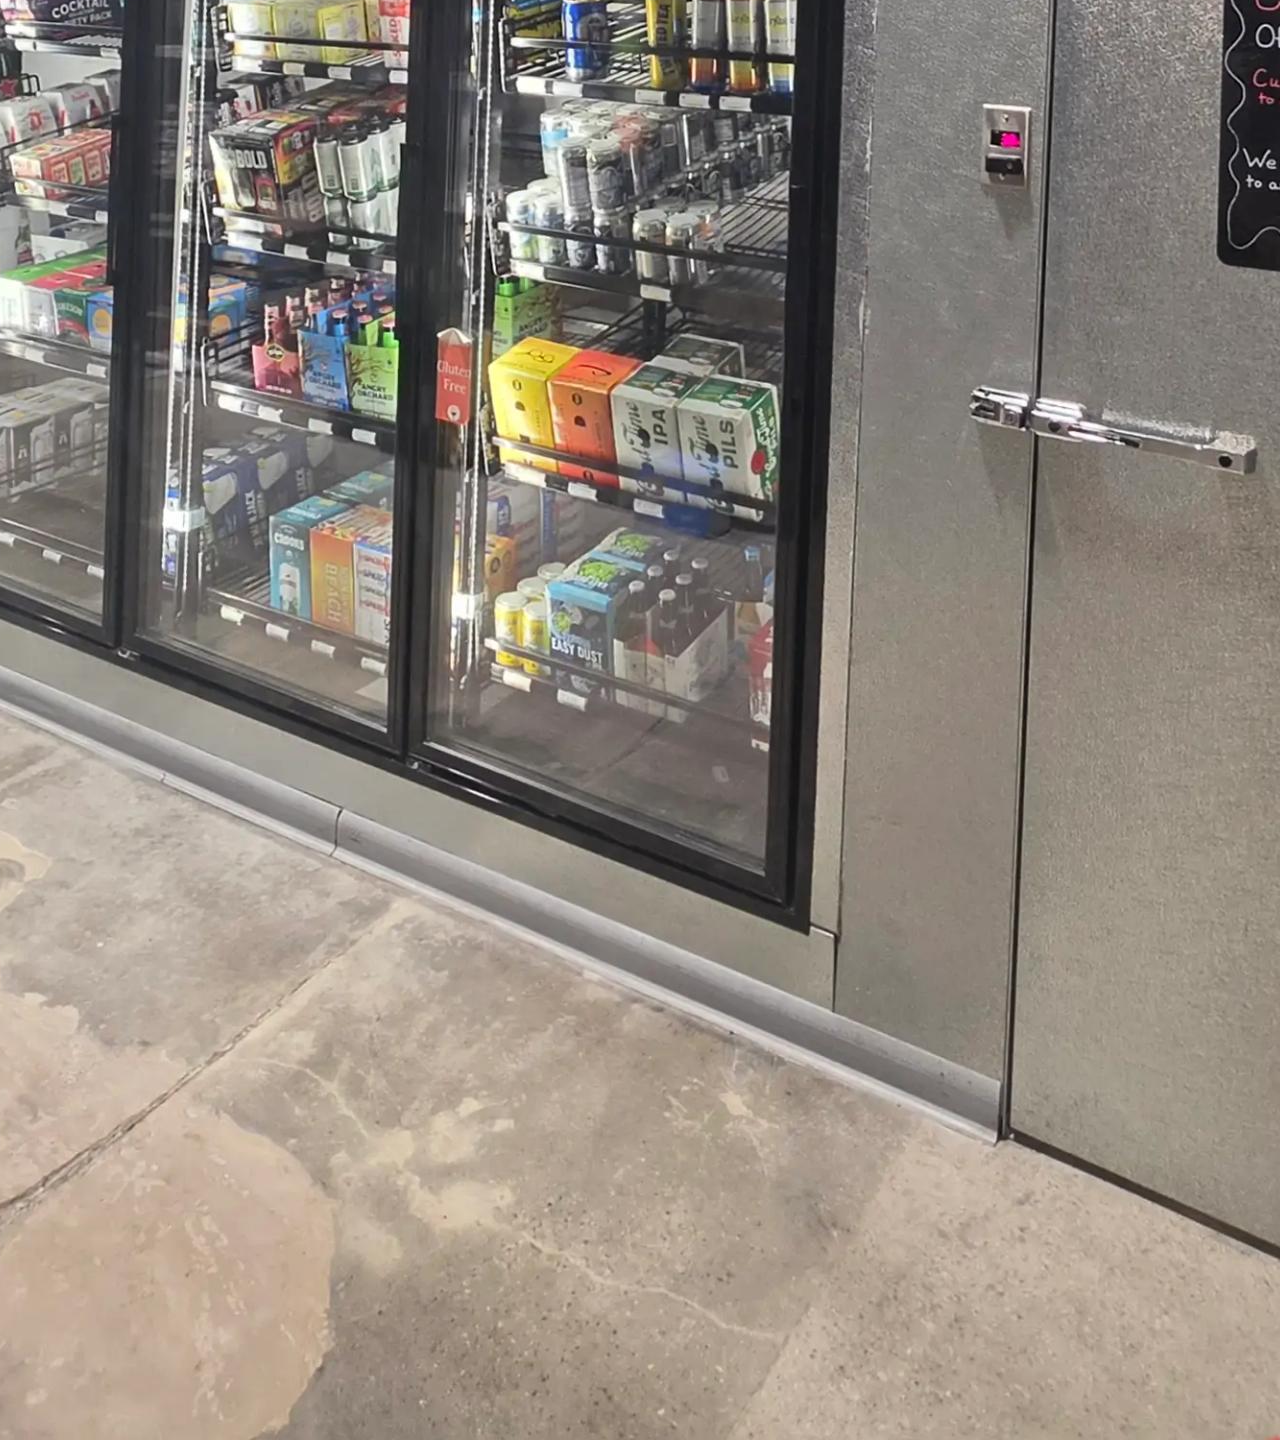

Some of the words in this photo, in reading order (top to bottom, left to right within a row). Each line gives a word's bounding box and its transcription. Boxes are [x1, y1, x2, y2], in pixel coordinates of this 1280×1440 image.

[1257, 92, 1275, 105] to
[234, 149, 268, 169] BOLD
[1242, 147, 1277, 170] We
[1245, 174, 1263, 189] to
[436, 359, 471, 378] Gluten
[443, 378, 466, 395] Free
[652, 408, 669, 446] IPA
[719, 419, 740, 470] PILS
[551, 637, 575, 656] EASY
[577, 646, 603, 664] DUST
